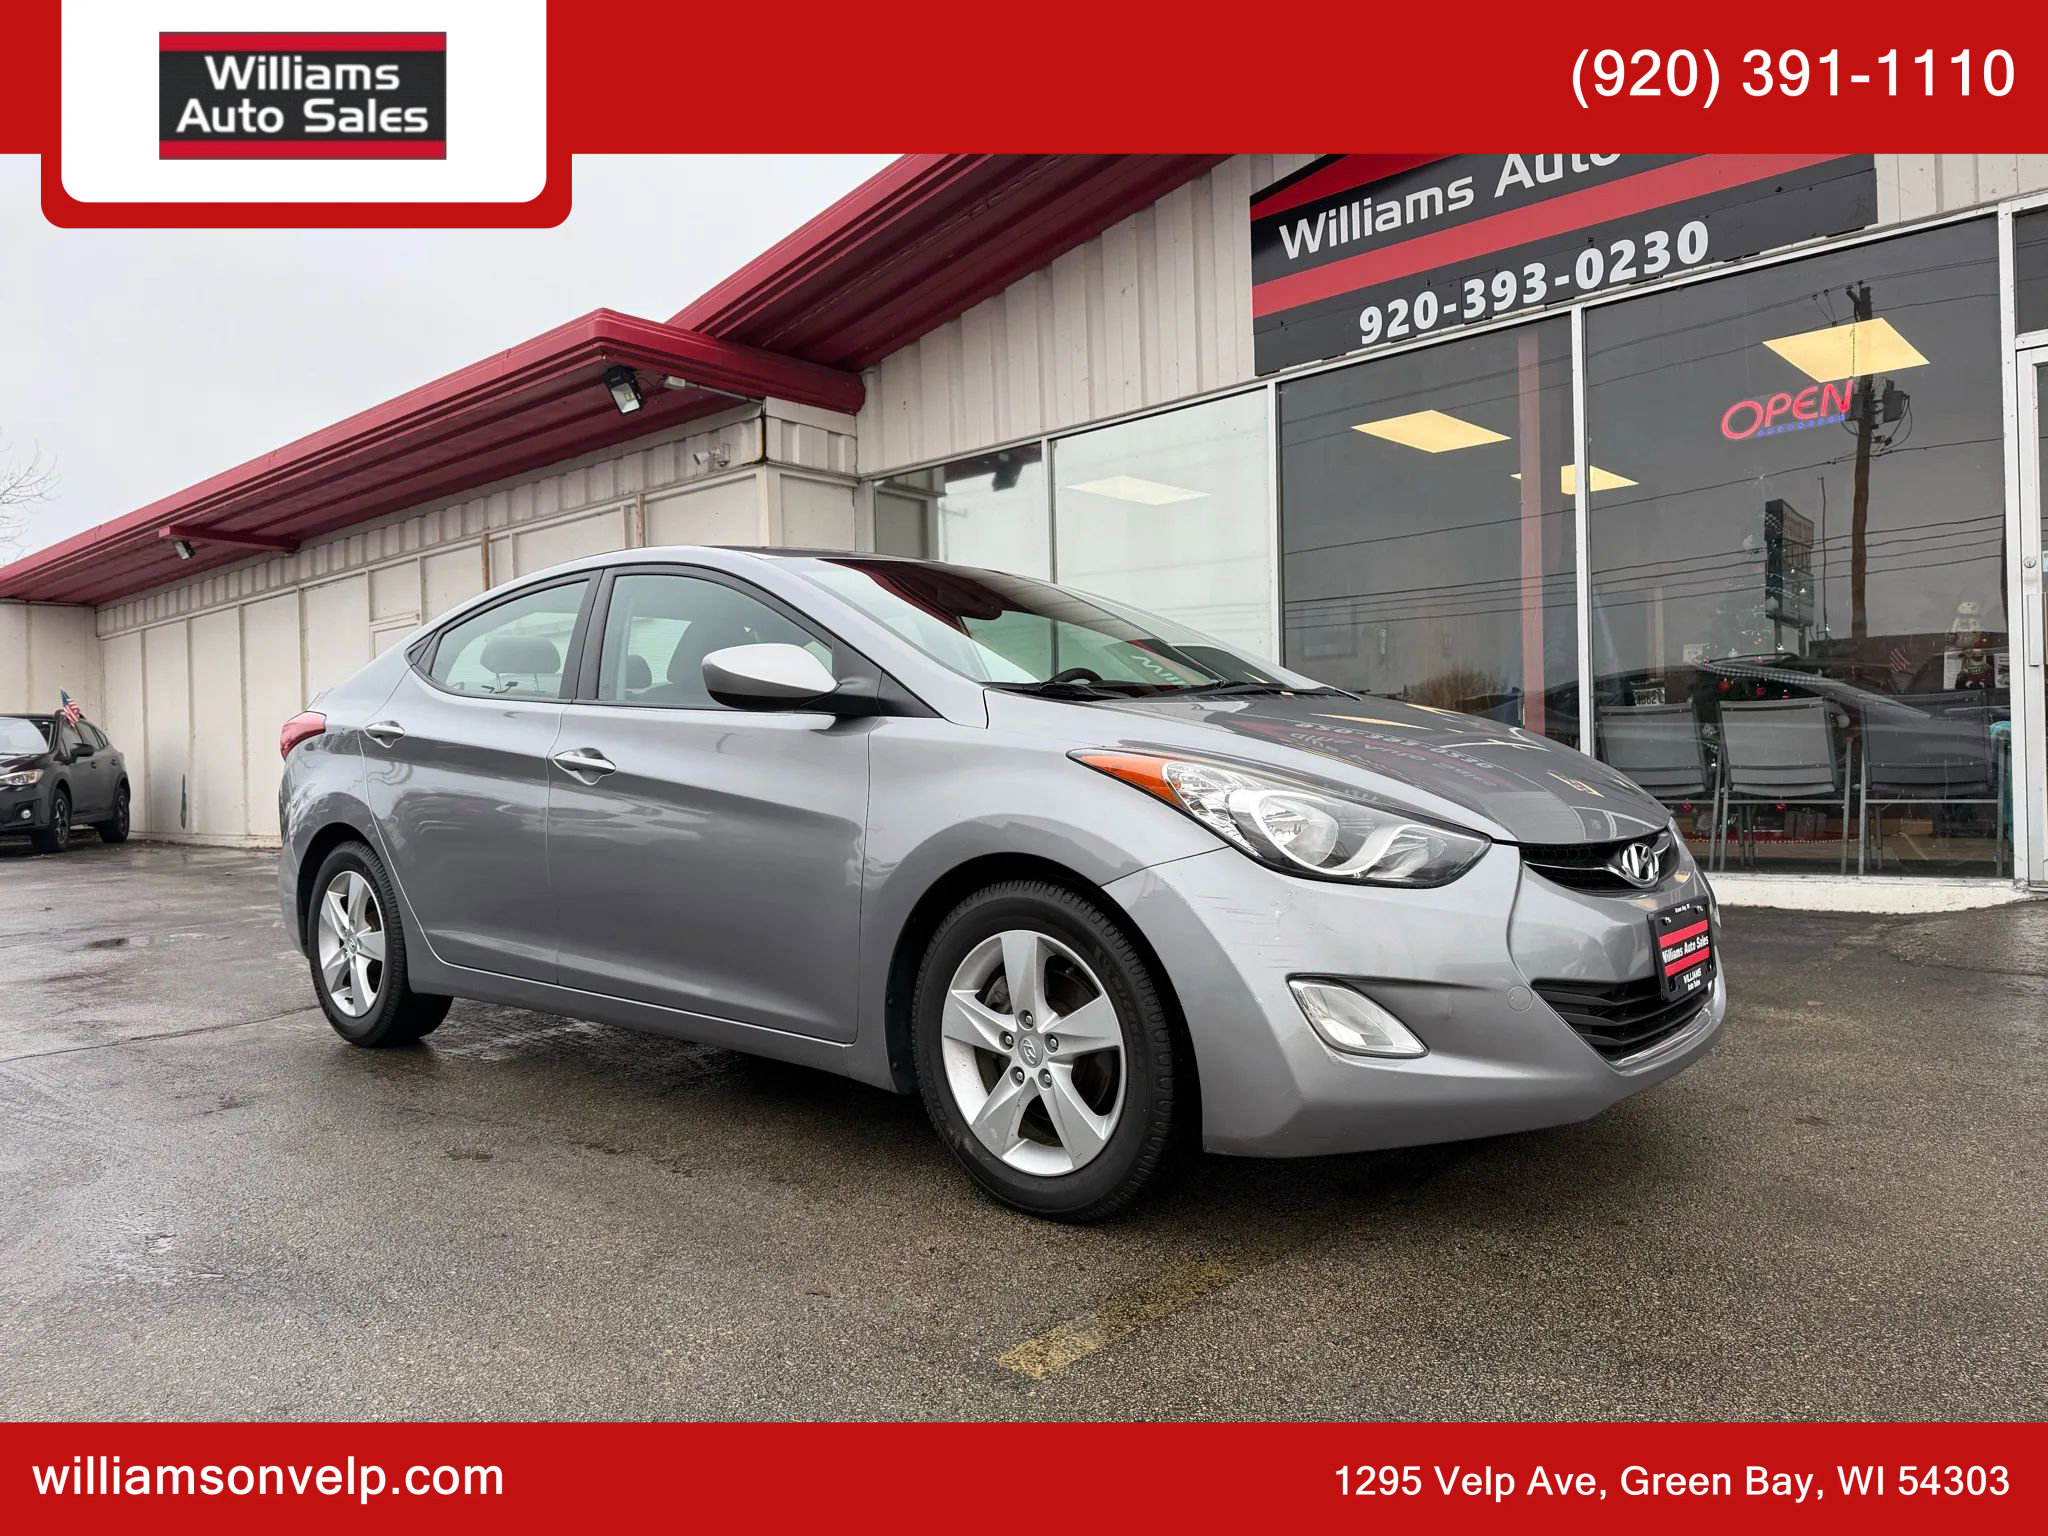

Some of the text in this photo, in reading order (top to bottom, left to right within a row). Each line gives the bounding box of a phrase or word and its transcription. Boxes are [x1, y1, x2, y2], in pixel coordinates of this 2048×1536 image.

[1279, 175, 1475, 260] Williams
[1359, 220, 1709, 345] 920-393-0230
[1722, 378, 1854, 440] OPEN
